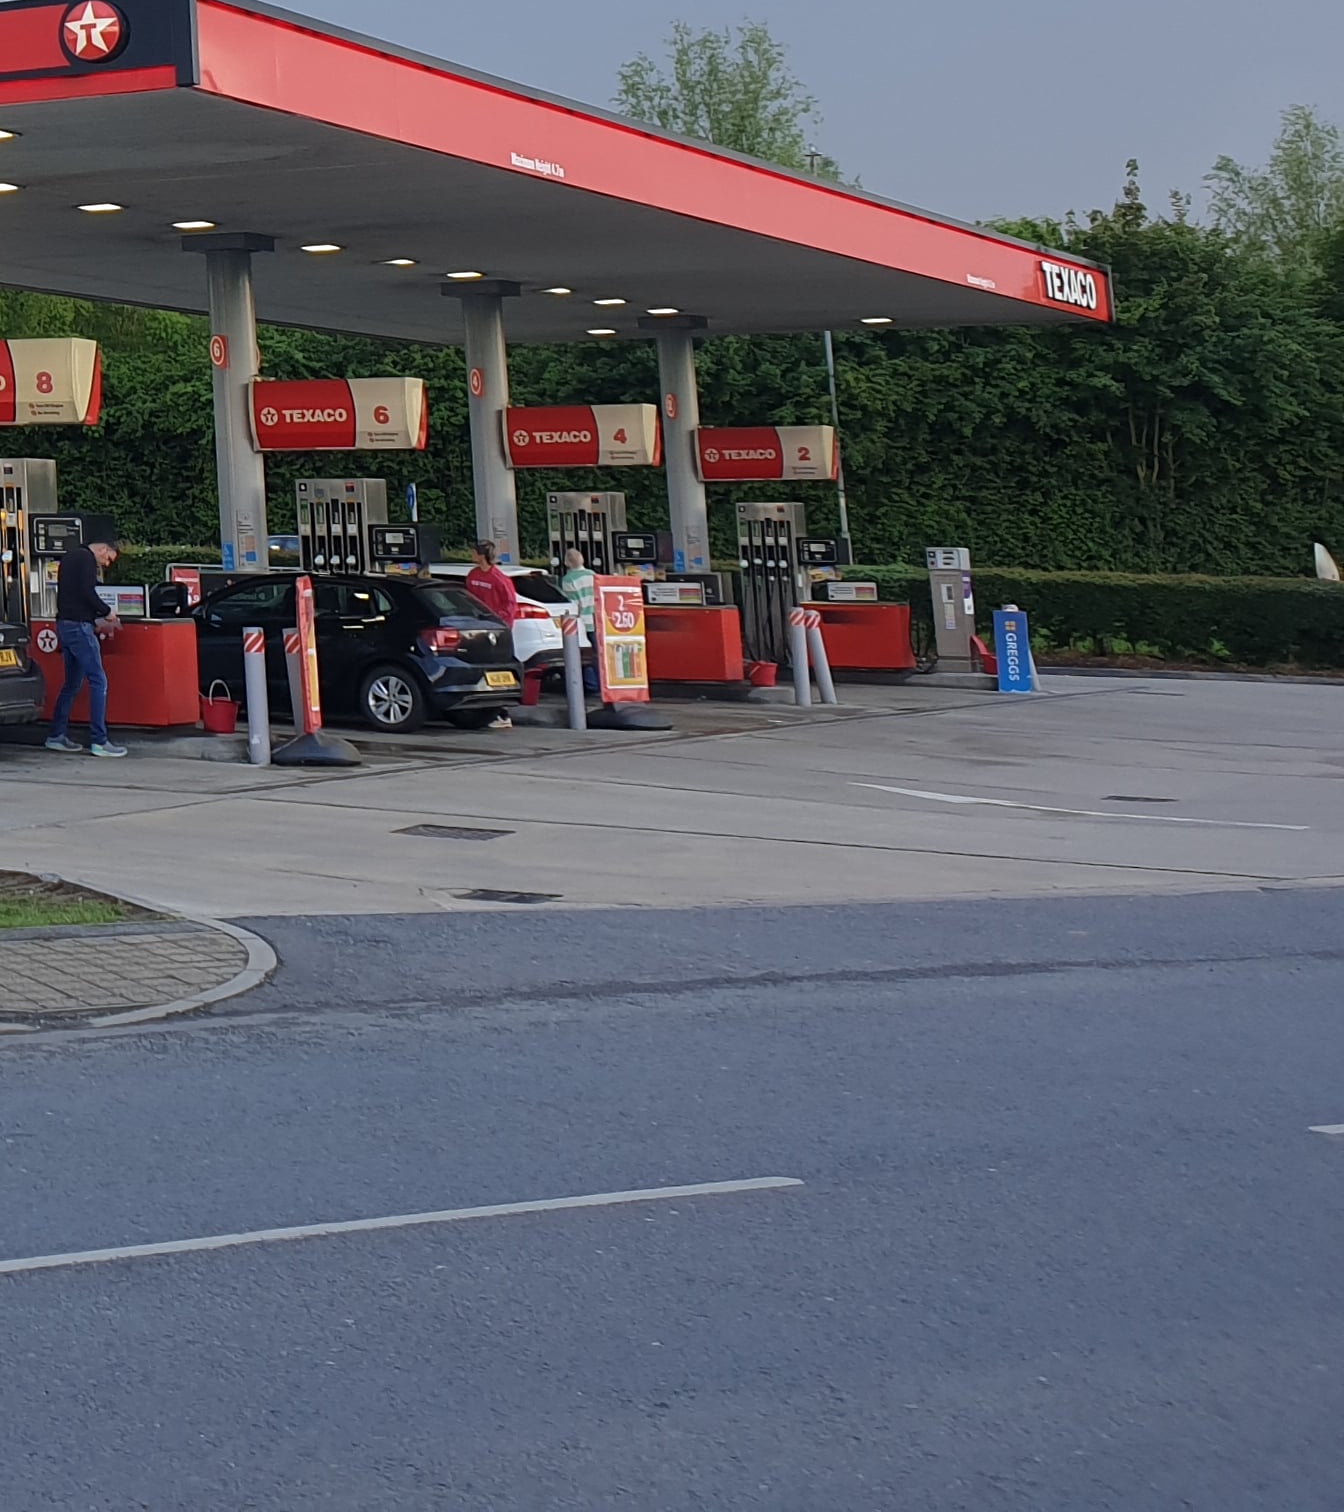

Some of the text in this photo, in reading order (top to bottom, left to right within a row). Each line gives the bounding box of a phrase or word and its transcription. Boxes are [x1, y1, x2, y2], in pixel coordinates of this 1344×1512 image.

[1041, 261, 1097, 310] TEXACO
[35, 370, 54, 395] 8
[281, 408, 348, 423] TEXACO
[373, 404, 391, 425] 6
[532, 430, 592, 444] TEXACO
[613, 427, 628, 445] 4
[721, 448, 777, 461] TEXACO
[797, 446, 812, 461] 2
[1004, 632, 1020, 682] GREGGS
